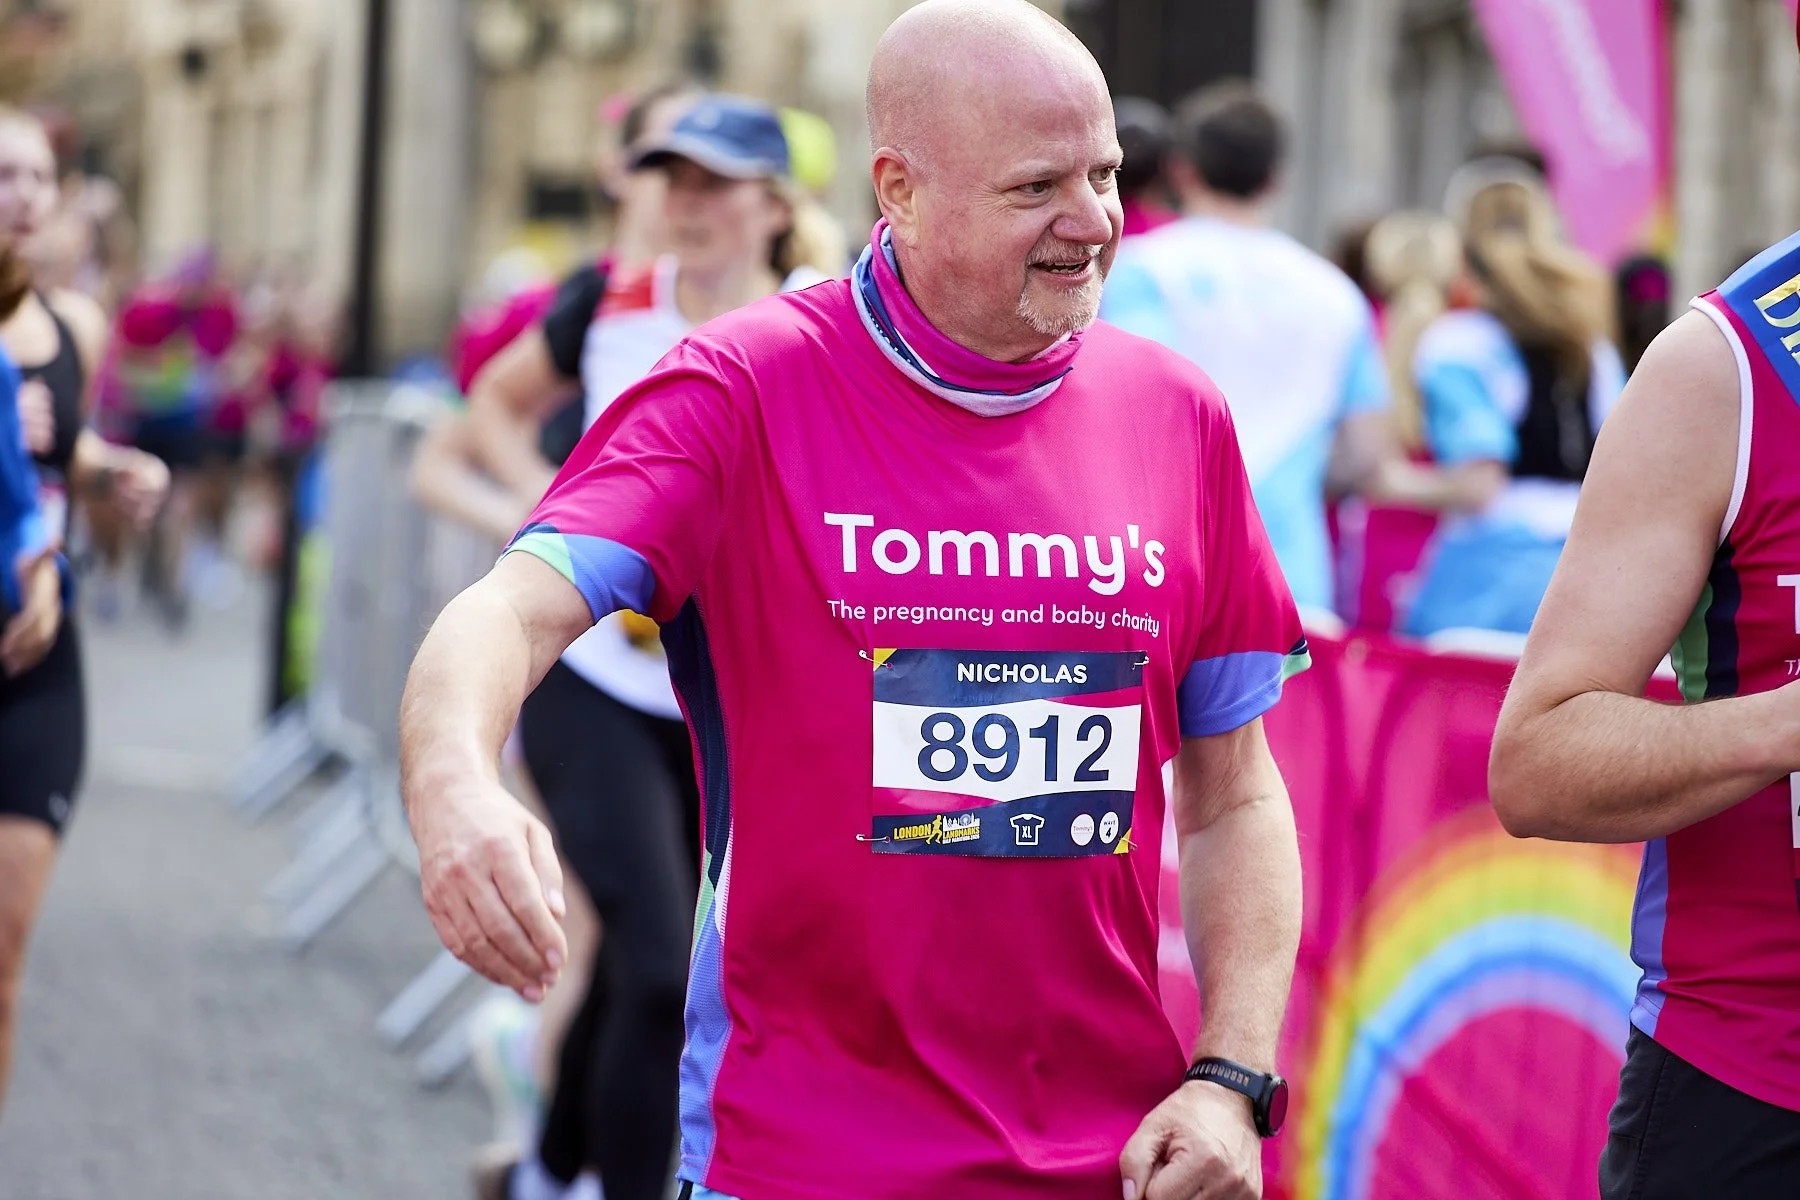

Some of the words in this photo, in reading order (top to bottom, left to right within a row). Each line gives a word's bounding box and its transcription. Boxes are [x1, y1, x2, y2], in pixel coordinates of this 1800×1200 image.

[824, 511, 1166, 596] Tommy's
[827, 599, 866, 620] The
[873, 605, 994, 627] pregnancy
[1001, 603, 1044, 624] and
[1052, 603, 1106, 630] baby
[1111, 607, 1160, 638] charity
[957, 662, 1088, 684] NICHOLAS
[917, 712, 1113, 782] 8912
[893, 823, 932, 840] LONDON
[942, 826, 980, 840] LANDMARKS
[1021, 825, 1033, 839] XL
[1105, 827, 1112, 838] 4
